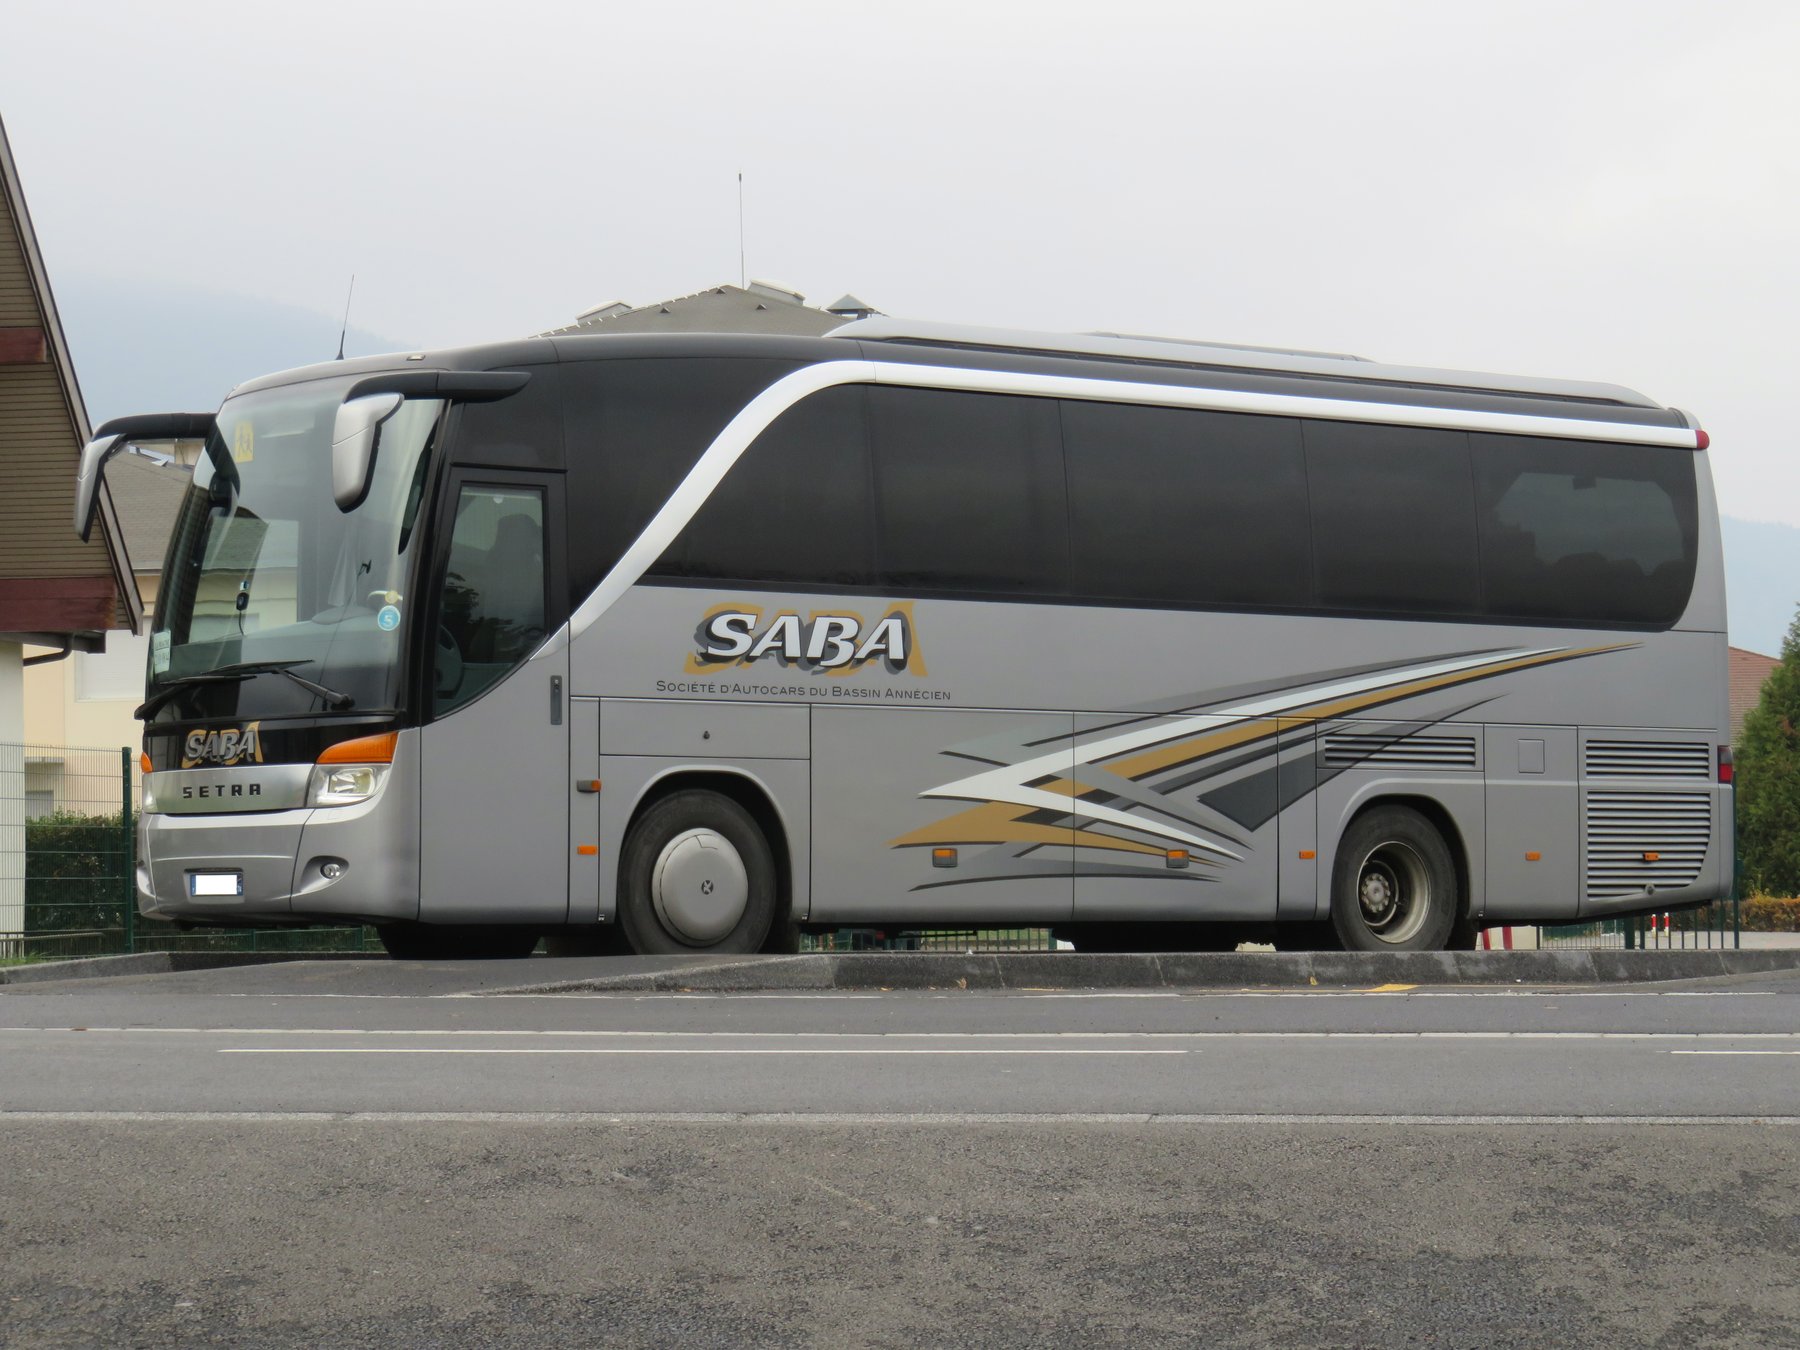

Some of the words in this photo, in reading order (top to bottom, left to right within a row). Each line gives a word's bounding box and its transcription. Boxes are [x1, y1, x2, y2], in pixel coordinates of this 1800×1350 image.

[695, 609, 911, 673] SABA
[184, 726, 259, 763] SABA
[182, 784, 261, 799] SETRA
